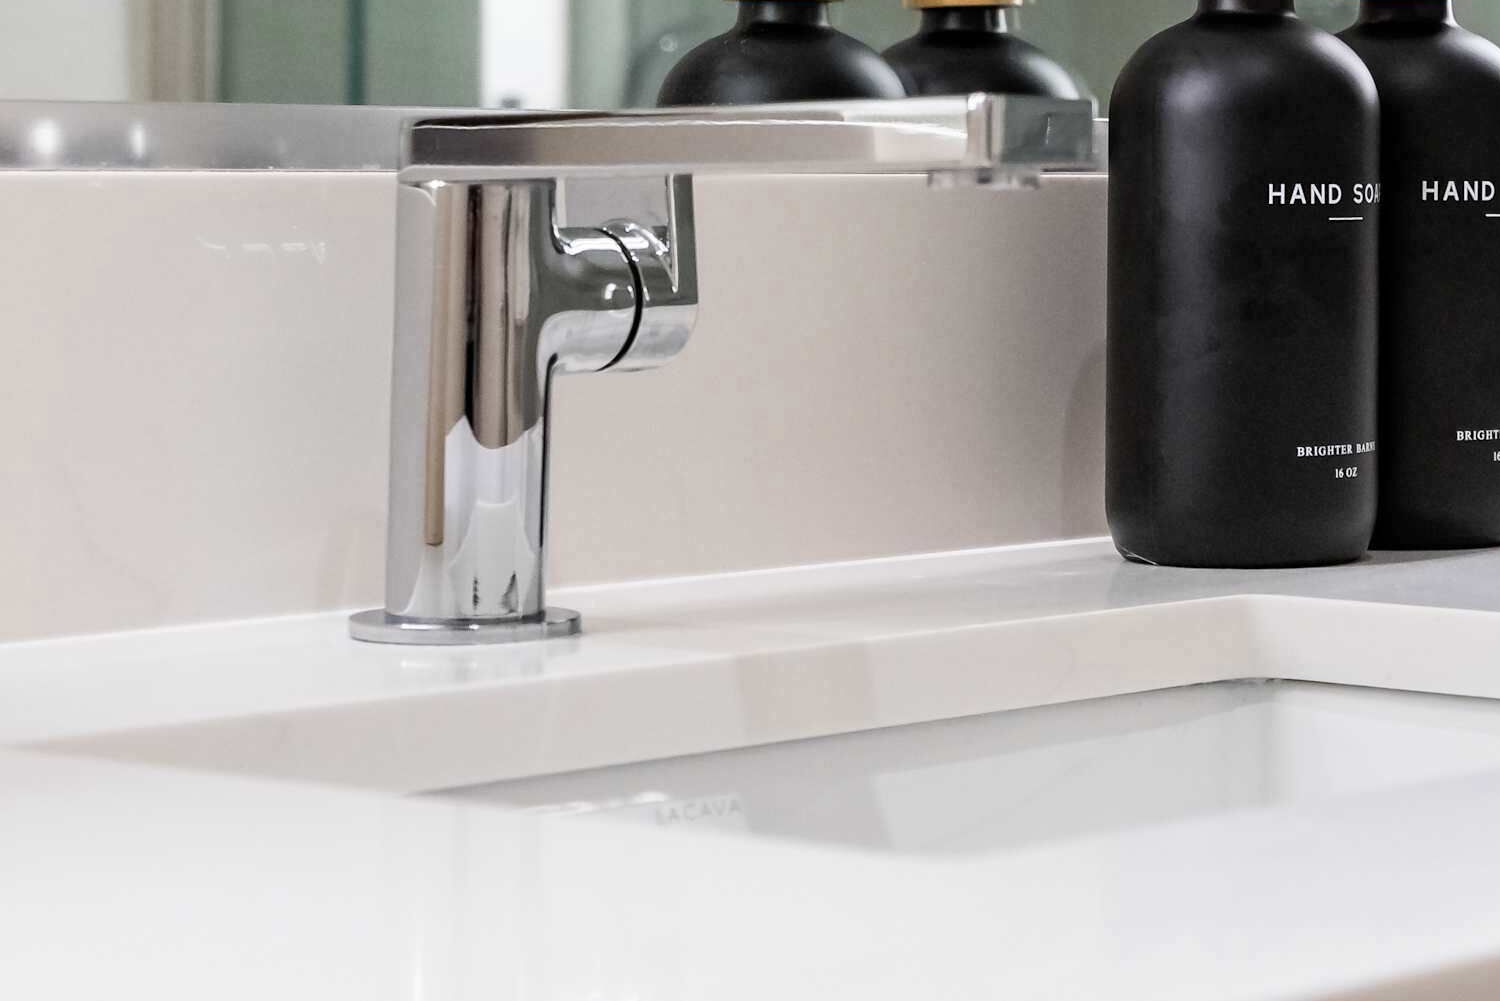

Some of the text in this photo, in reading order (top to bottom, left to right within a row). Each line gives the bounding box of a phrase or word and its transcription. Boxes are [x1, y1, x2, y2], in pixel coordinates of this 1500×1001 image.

[1268, 183, 1342, 205] HAND
[1421, 180, 1495, 202] HAND
[1296, 443, 1353, 457] BRIGHTER
[1335, 467, 1358, 479] 16 OZ
